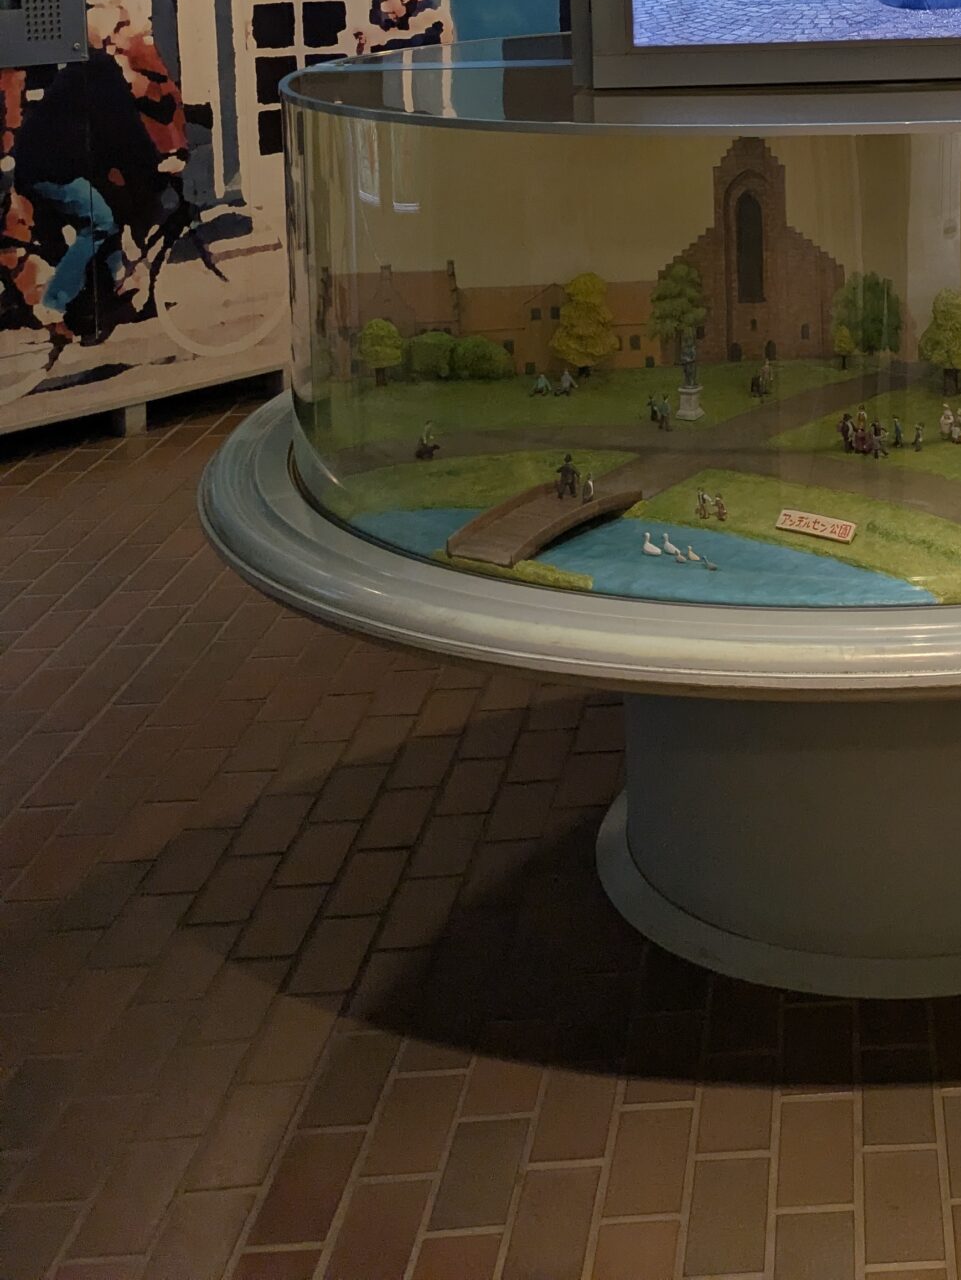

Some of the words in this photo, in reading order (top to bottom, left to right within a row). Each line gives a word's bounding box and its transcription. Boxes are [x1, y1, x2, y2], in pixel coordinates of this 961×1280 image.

[780, 512, 852, 538] アンデルセン公園
